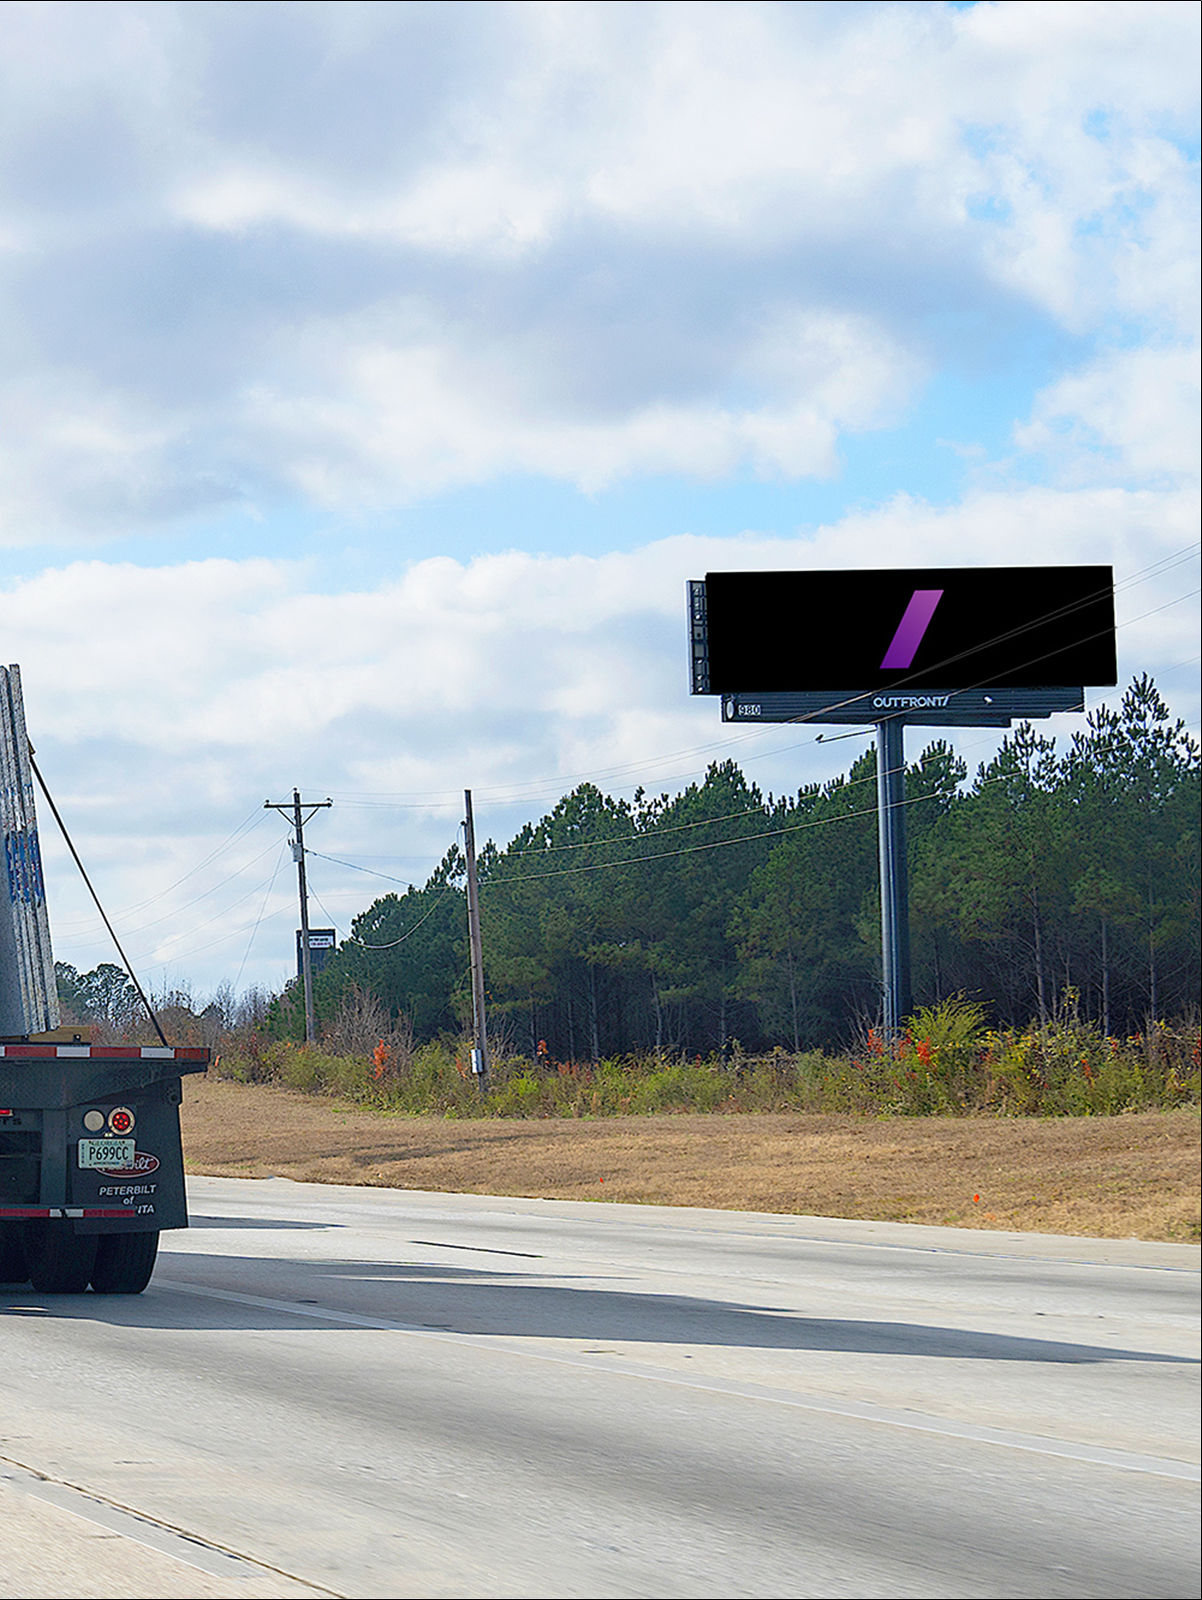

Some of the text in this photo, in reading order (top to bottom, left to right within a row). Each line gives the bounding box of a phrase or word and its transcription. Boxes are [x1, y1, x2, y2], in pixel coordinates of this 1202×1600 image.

[738, 704, 762, 716] 980
[89, 1146, 129, 1160] P699CC
[99, 1184, 157, 1196] PETERBILT
[123, 1196, 134, 1205] of
